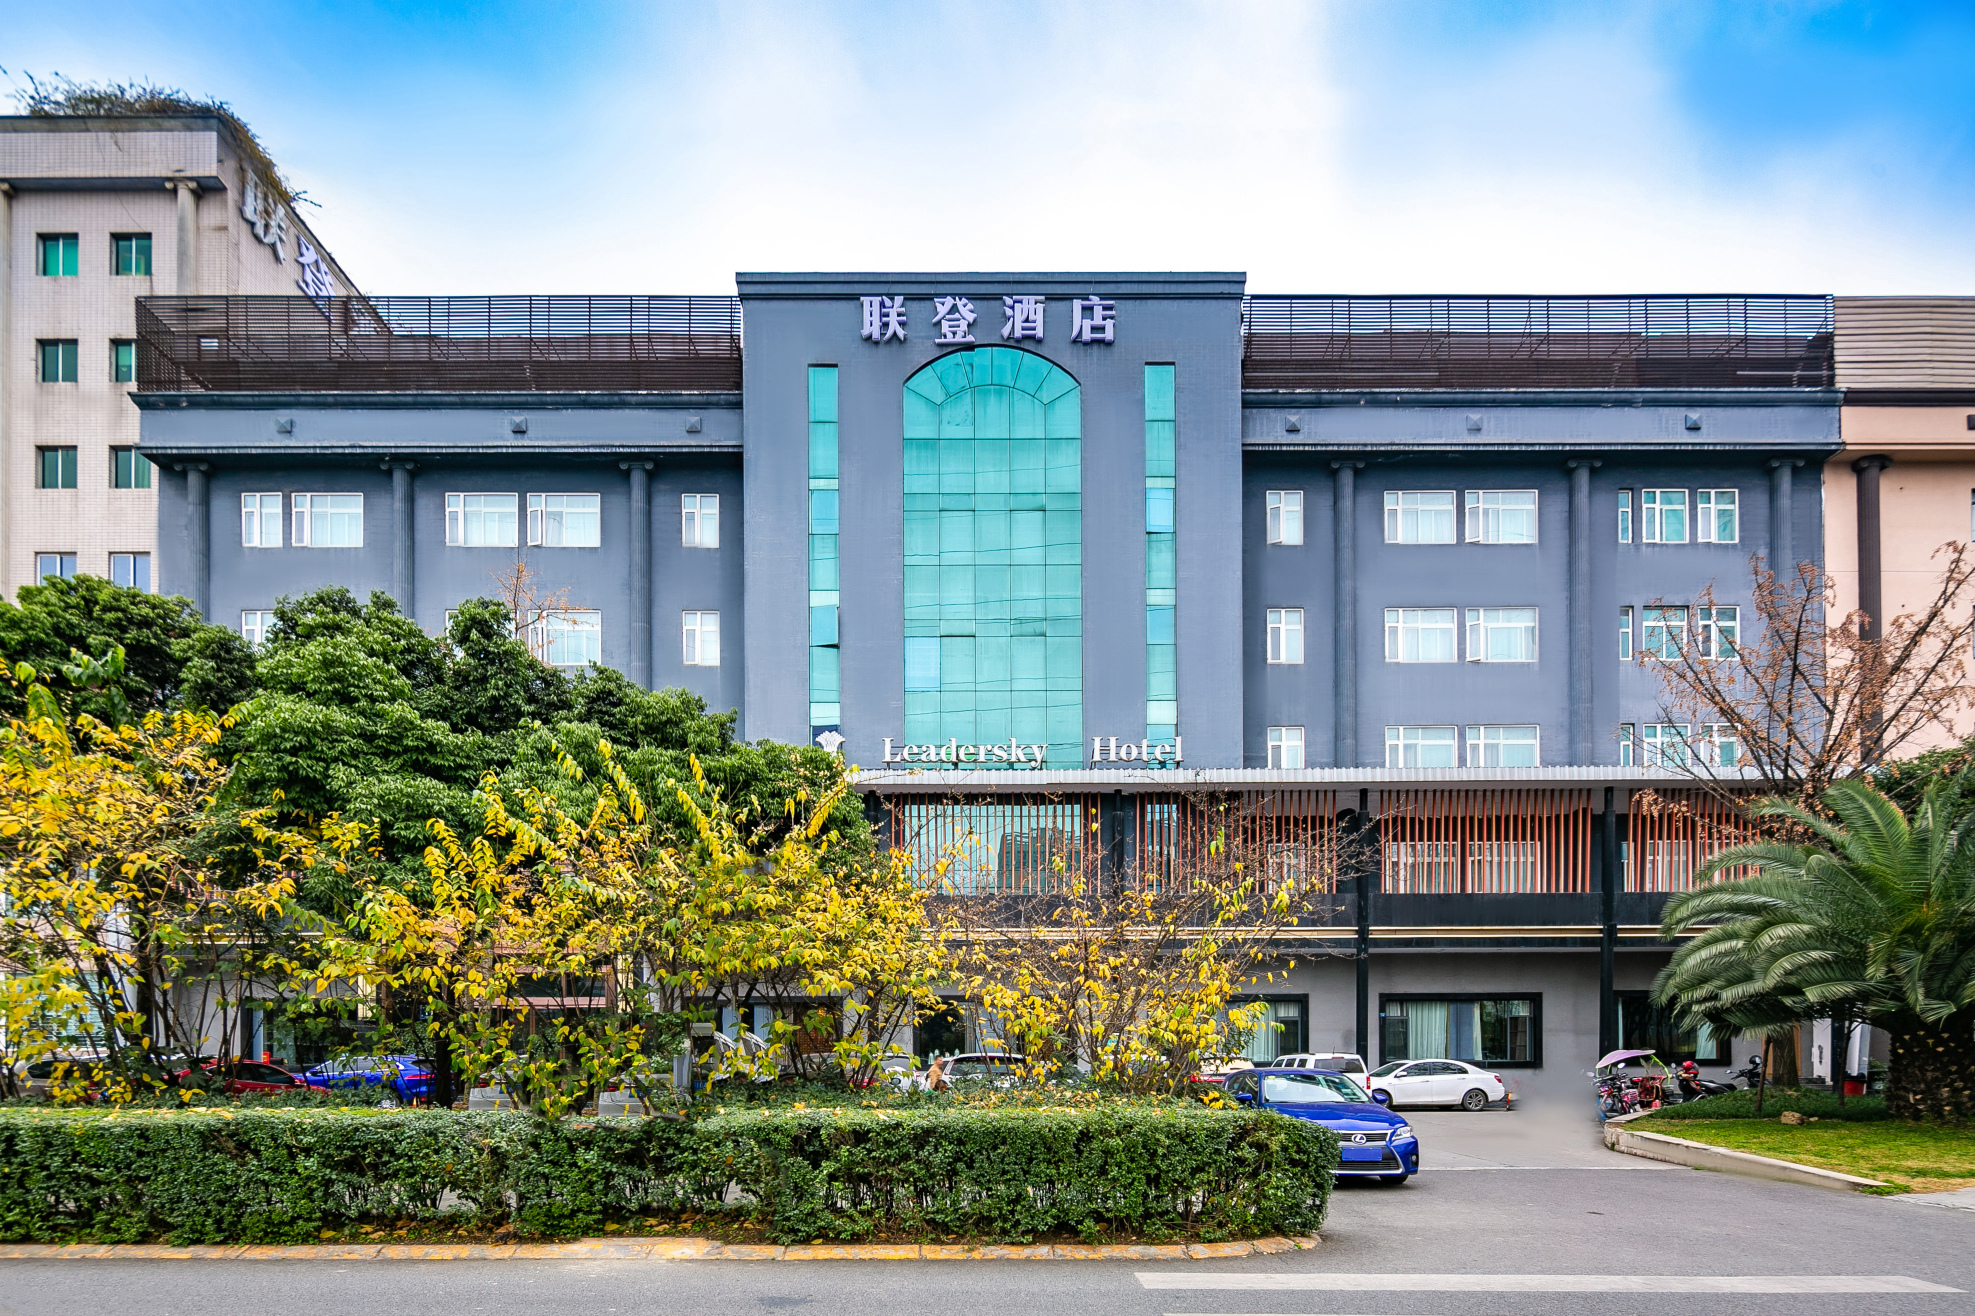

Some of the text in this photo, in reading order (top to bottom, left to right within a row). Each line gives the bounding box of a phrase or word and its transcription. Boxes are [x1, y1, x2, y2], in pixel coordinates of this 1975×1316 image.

[860, 295, 1116, 345] 联登酒店
[881, 736, 1183, 768] Leadersky Hotel
